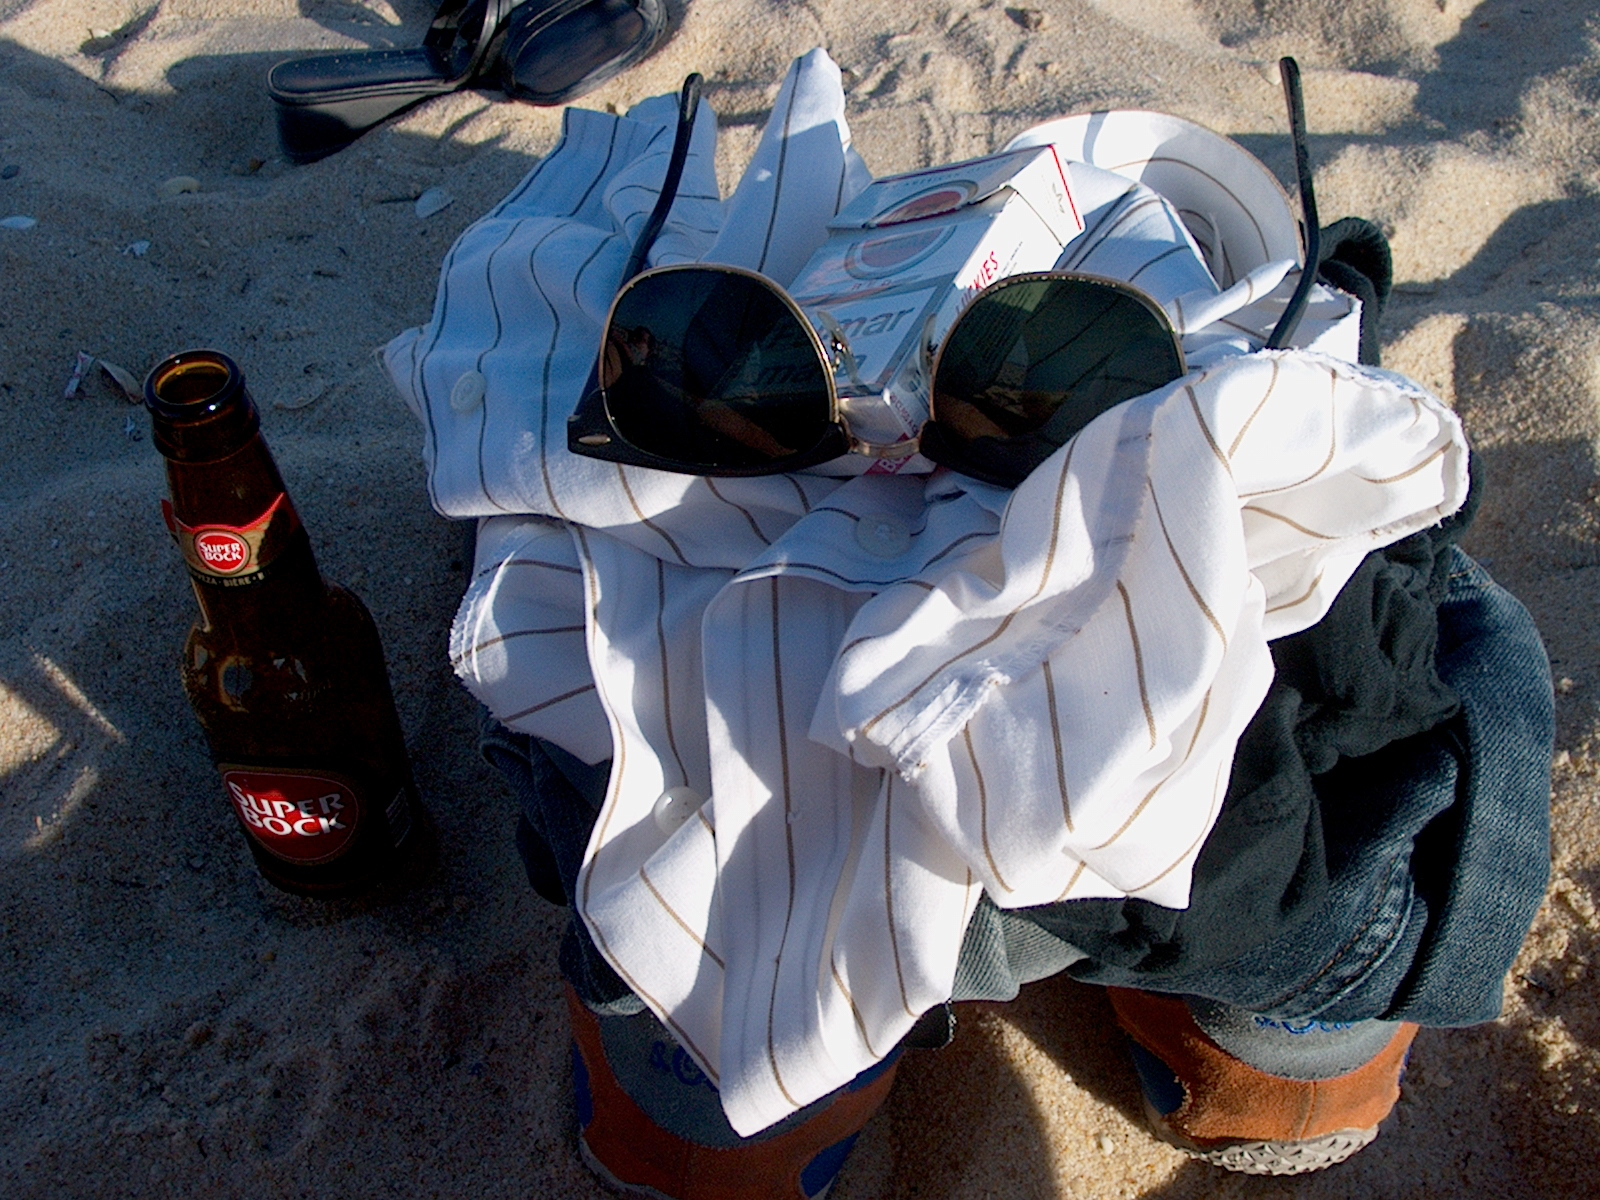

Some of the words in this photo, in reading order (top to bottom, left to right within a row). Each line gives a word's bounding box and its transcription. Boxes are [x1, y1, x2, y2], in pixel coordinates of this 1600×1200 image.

[200, 541, 241, 553] SUPER
[204, 550, 242, 562] BOCK
[228, 781, 345, 819] SUPER
[240, 804, 346, 836] BOCK
